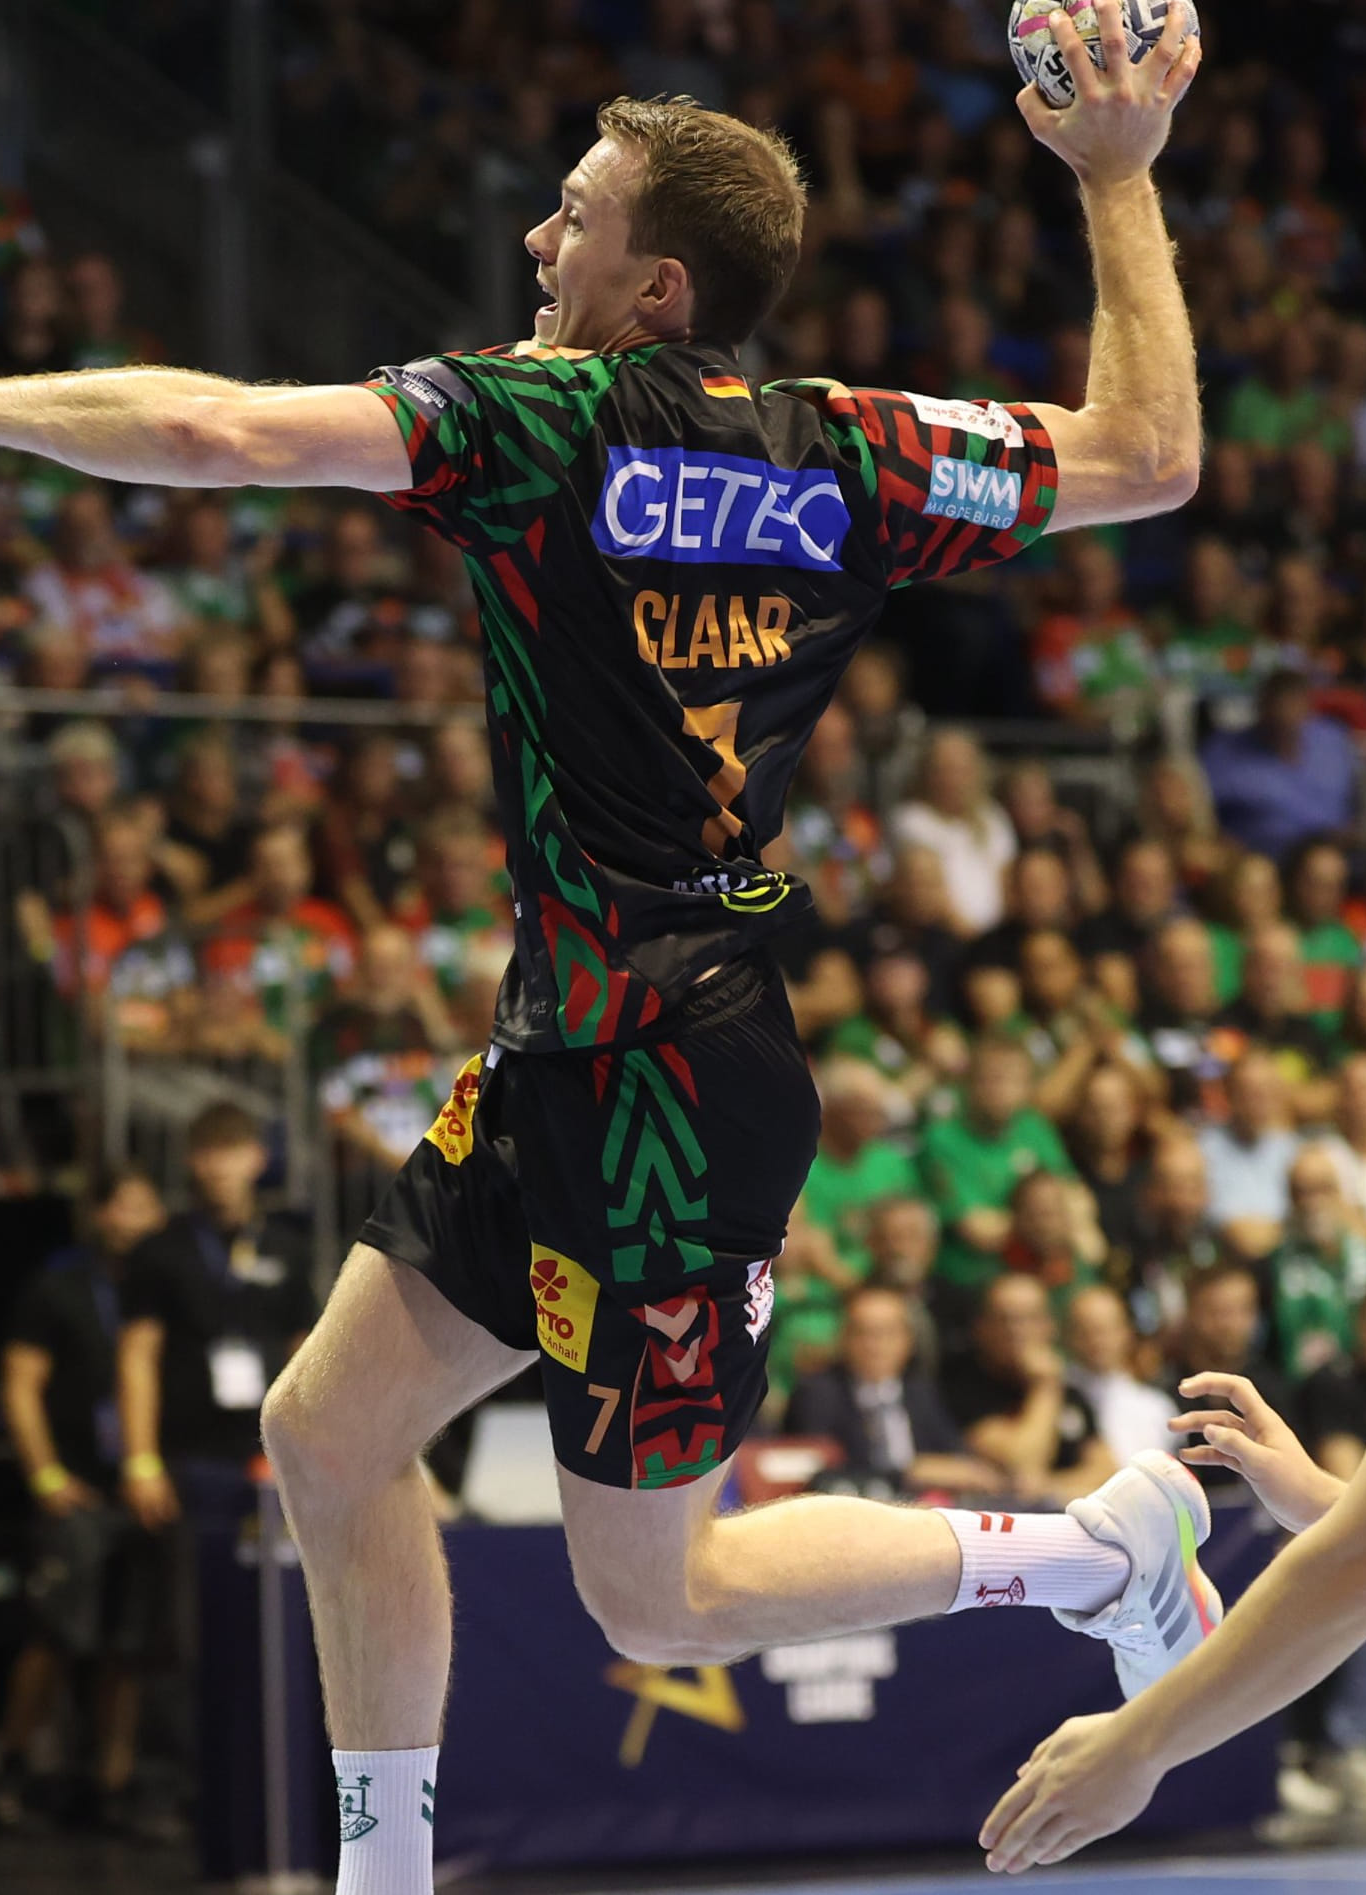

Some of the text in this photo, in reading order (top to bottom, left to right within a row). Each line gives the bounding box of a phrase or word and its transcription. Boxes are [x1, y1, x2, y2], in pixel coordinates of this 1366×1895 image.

[605, 460, 844, 562] GETEC
[933, 460, 1017, 511] SWM
[634, 589, 792, 669] CLAAR
[683, 702, 746, 857] 7
[584, 1384, 620, 1455] 7
